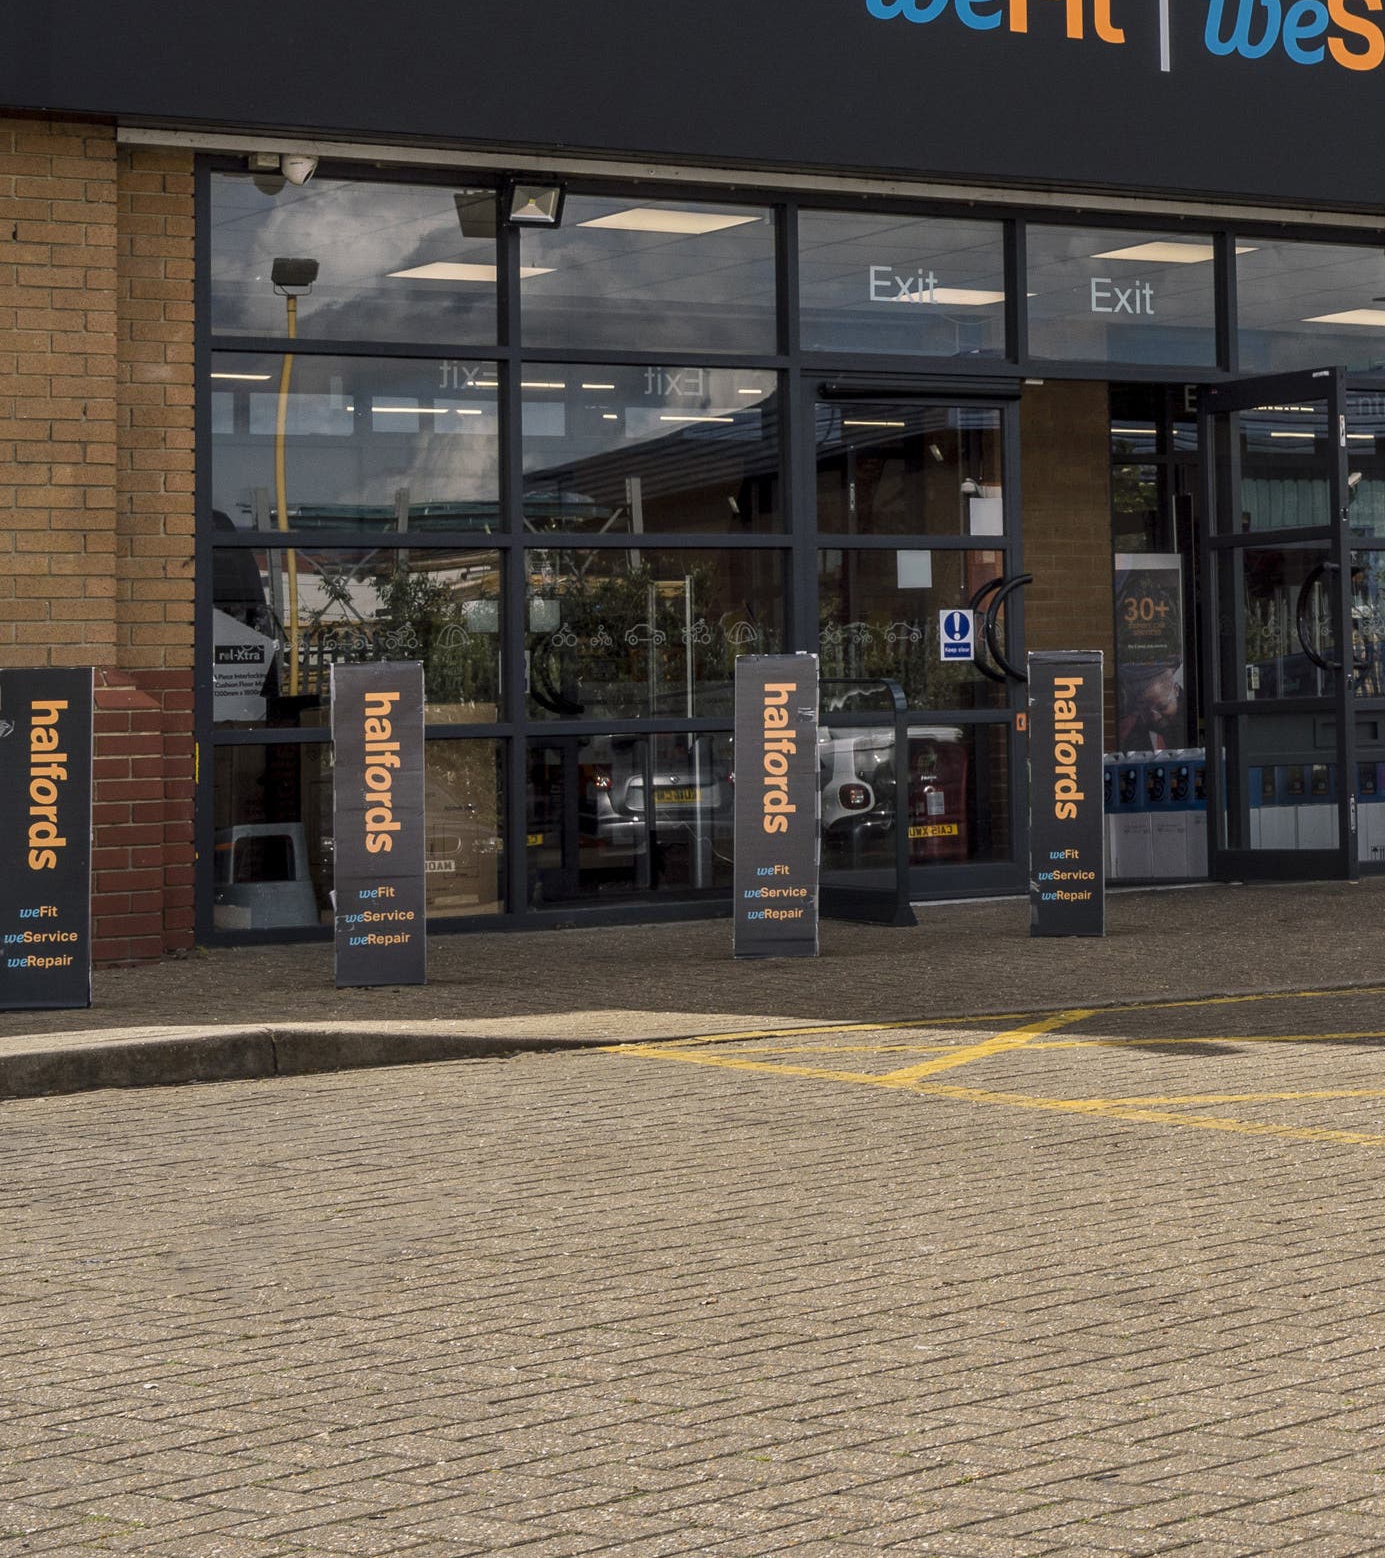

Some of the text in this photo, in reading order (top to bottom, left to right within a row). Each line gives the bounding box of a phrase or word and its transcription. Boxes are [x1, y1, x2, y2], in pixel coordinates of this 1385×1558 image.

[869, 265, 938, 304] Exit
[1090, 277, 1155, 315] Exit
[1123, 596, 1169, 621] 30+
[1053, 677, 1086, 821] halfords
[763, 683, 798, 835] halfords
[364, 691, 401, 854] halfords
[28, 700, 69, 871] halfords
[1050, 848, 1080, 860] weFit
[757, 864, 790, 876] weFit
[1038, 869, 1096, 881] weService
[359, 886, 395, 899] weFit
[744, 887, 807, 899] weService
[1041, 889, 1092, 902] weRepair
[19, 906, 58, 919] weFit
[345, 910, 415, 923] weService
[747, 908, 804, 921] weRepair
[3, 931, 78, 944] weService
[349, 933, 411, 946] weRepair
[7, 955, 73, 969] weRepair
